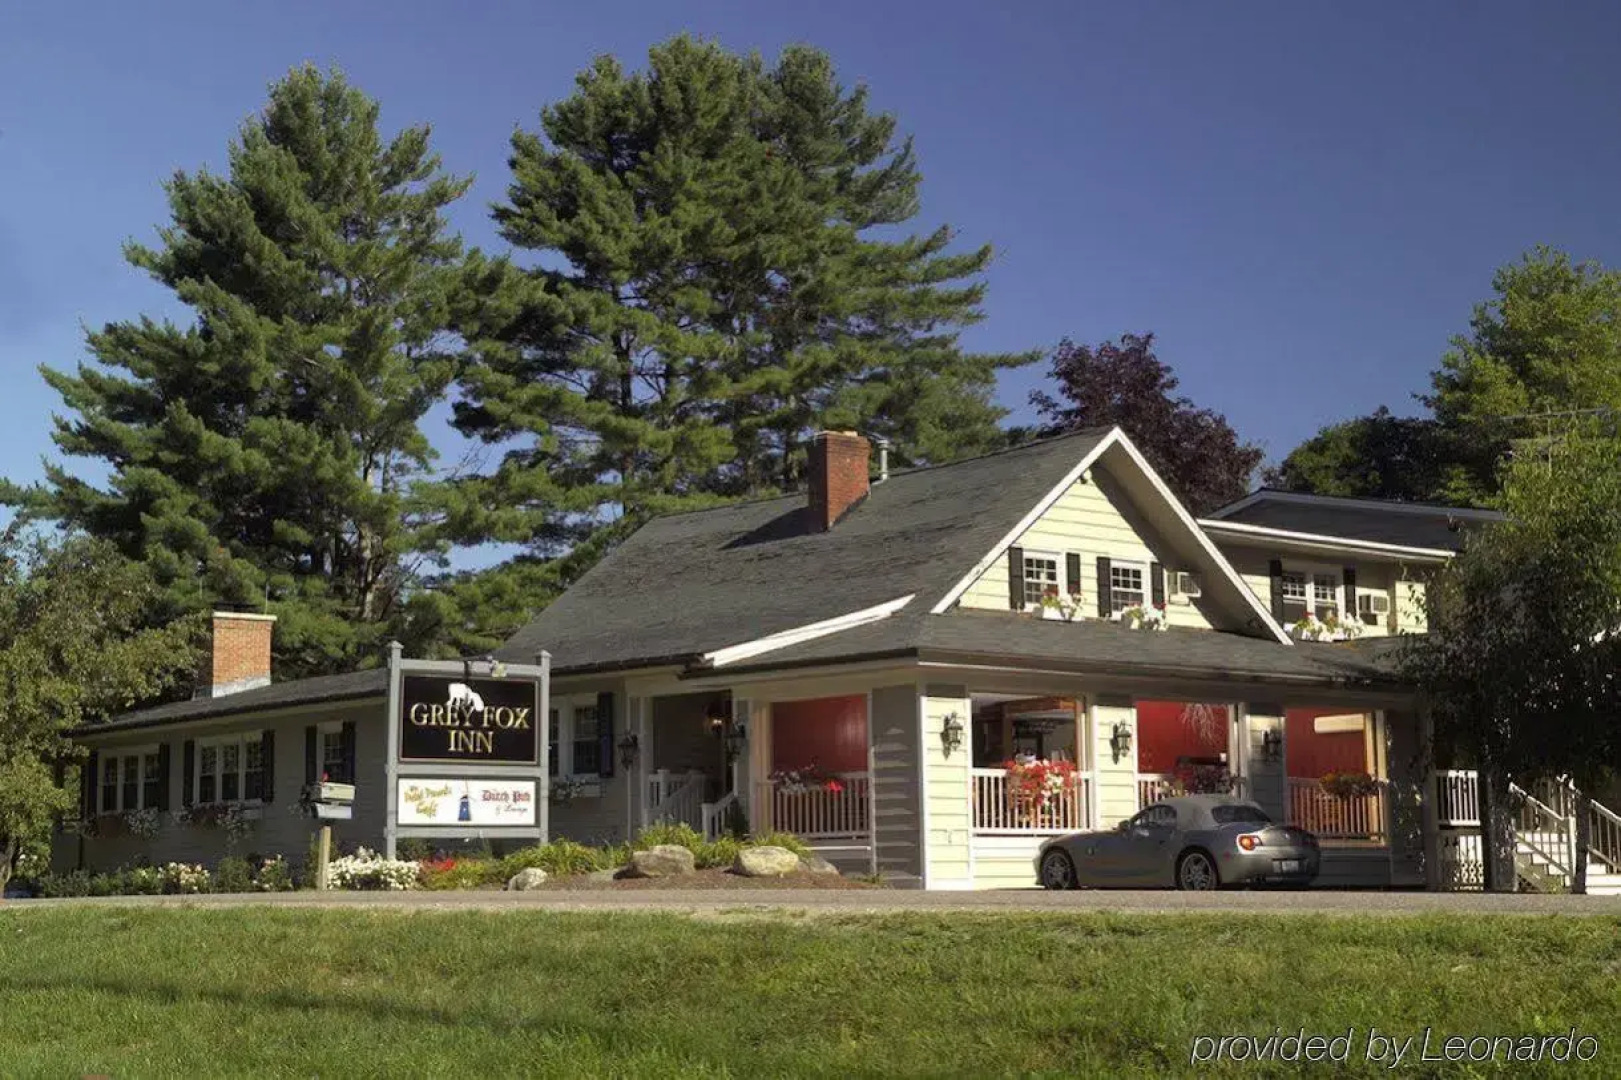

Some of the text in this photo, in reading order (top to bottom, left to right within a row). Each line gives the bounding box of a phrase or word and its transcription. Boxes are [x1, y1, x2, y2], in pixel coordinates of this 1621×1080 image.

[410, 702, 530, 730] GREY FOX
[448, 730, 494, 754] INN
